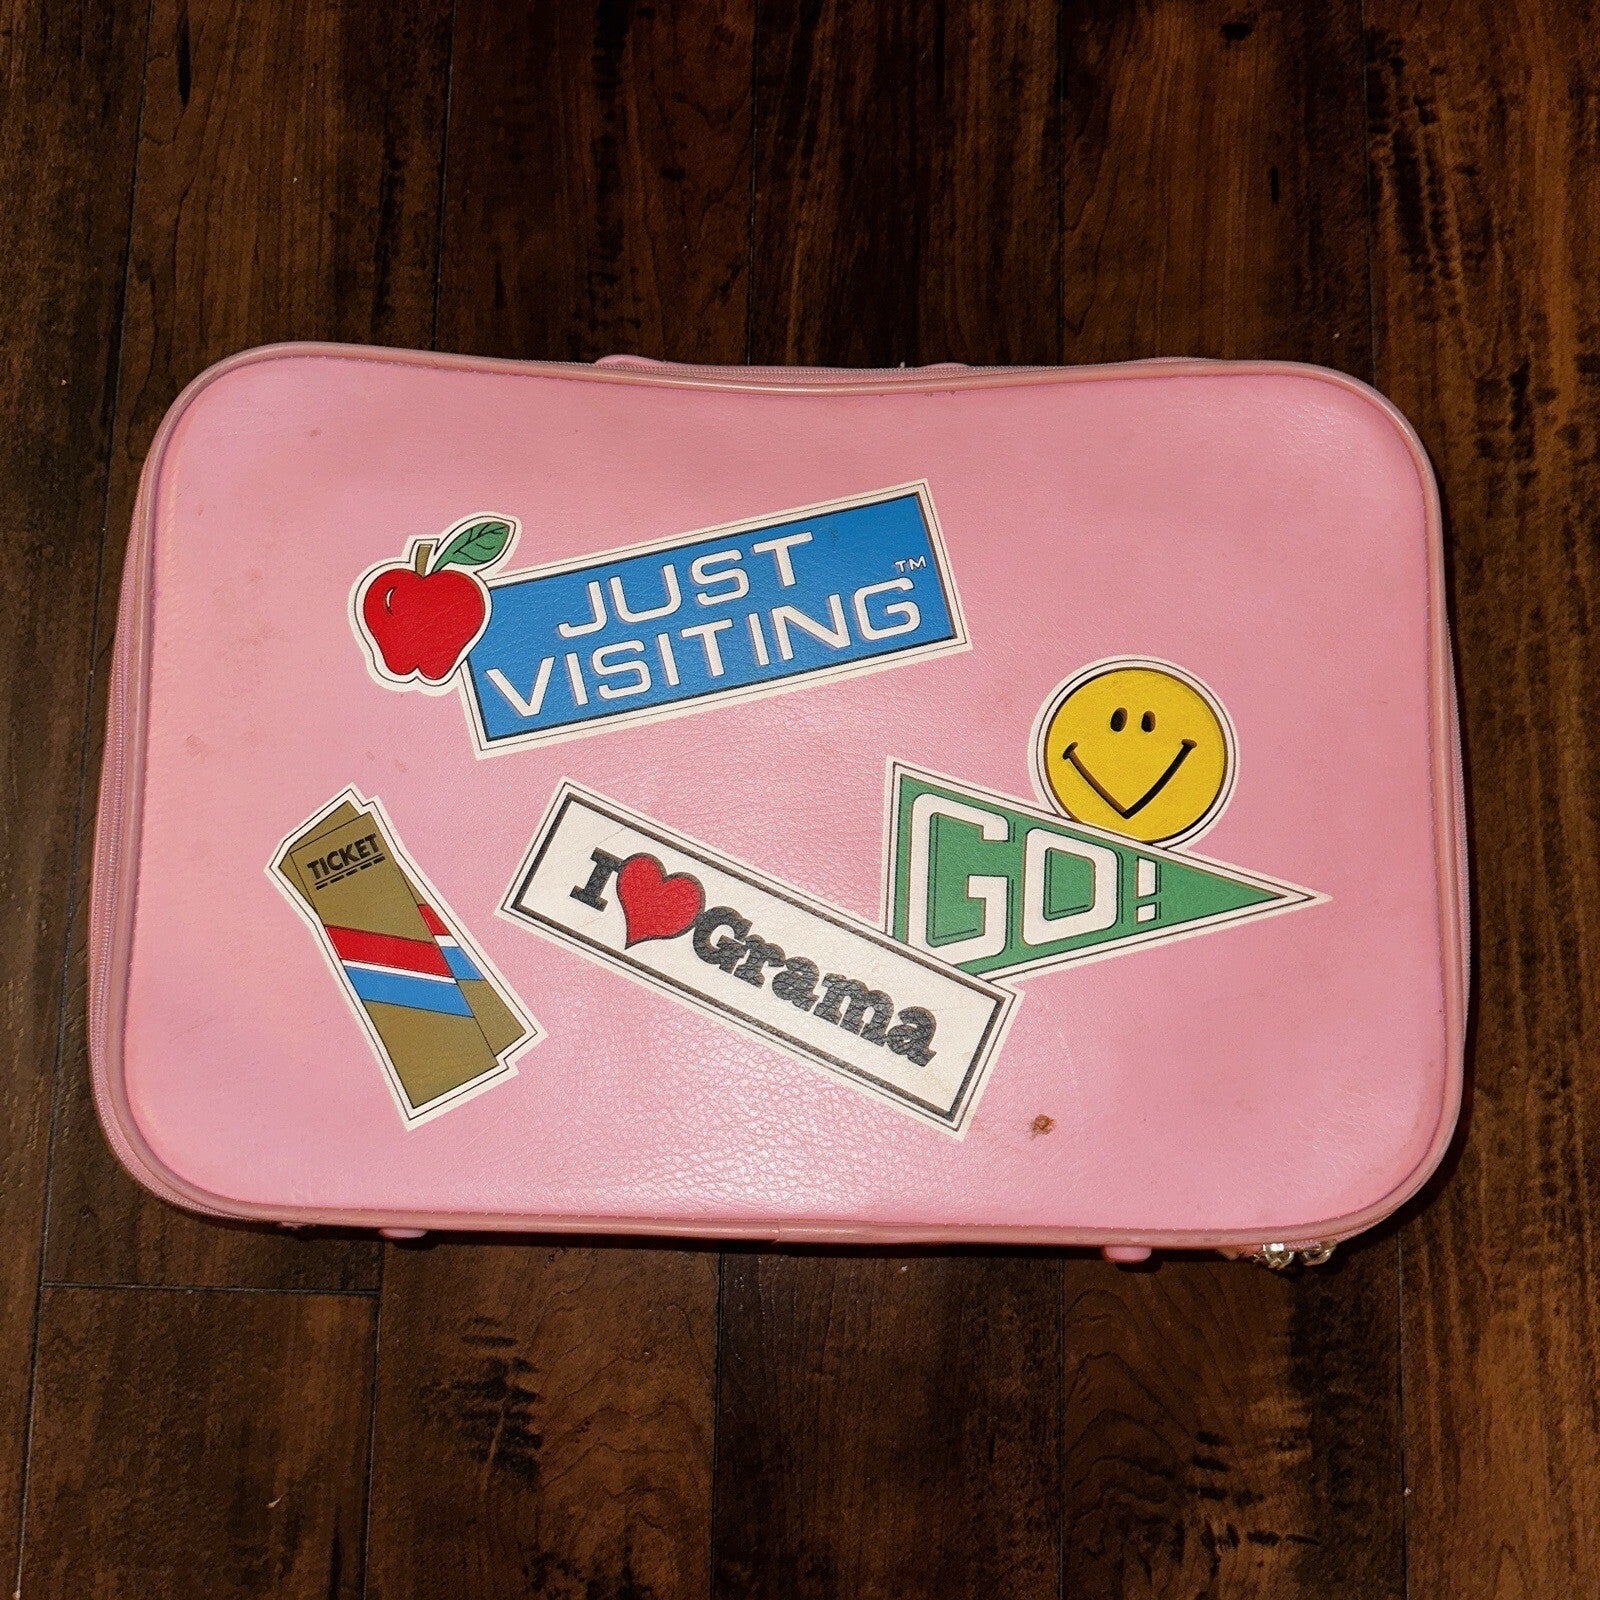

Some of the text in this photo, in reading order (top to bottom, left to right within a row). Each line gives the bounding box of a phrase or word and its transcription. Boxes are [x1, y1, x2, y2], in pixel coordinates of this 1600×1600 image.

[557, 531, 813, 639] JUST
[895, 555, 927, 575] TM
[486, 577, 921, 718] VISITING
[306, 833, 380, 881] TICKET
[907, 792, 1162, 966] GO!
[569, 846, 937, 1068] I Grama
